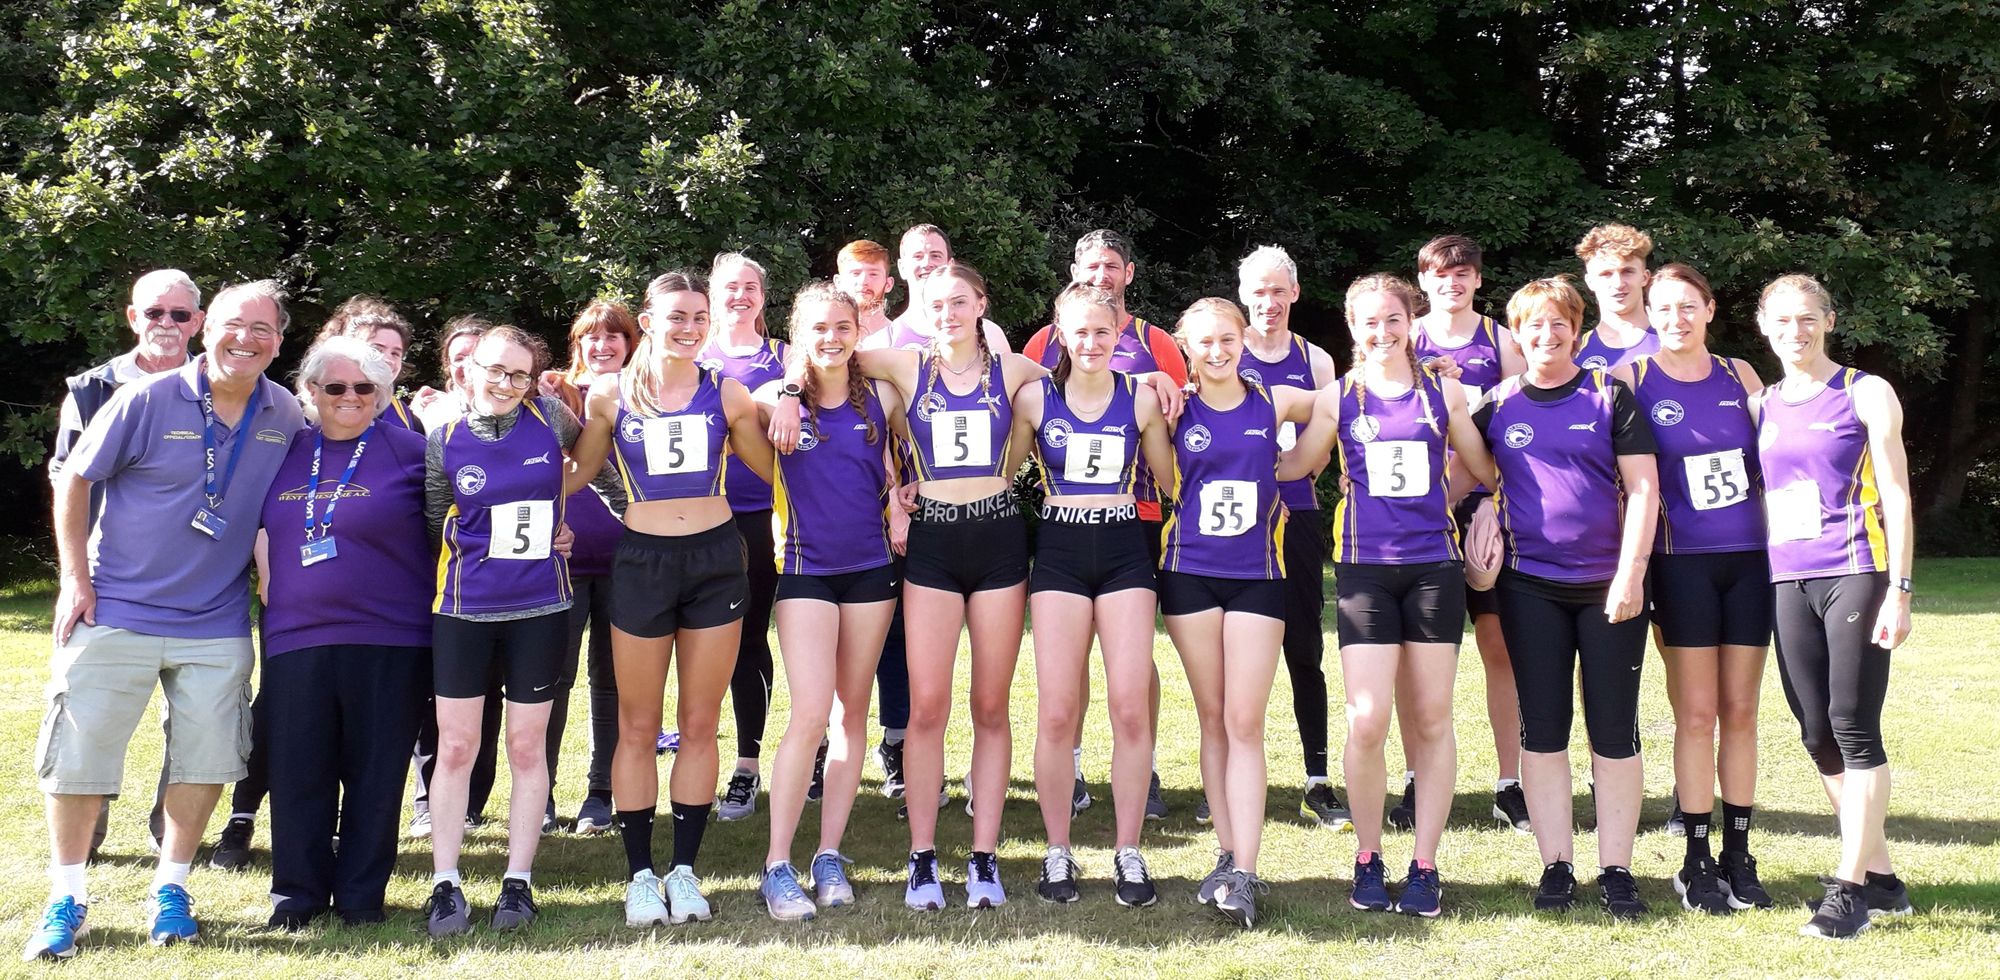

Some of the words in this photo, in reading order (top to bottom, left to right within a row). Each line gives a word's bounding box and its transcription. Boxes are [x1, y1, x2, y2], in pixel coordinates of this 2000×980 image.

[206, 448, 215, 470] UKA
[352, 441, 367, 458] UKA
[668, 437, 685, 468] 5
[954, 431, 969, 461] 5
[311, 459, 320, 475] UKA
[1084, 454, 1101, 478] 5
[1391, 462, 1406, 492] 5
[330, 484, 345, 502] UKA
[1704, 471, 1739, 504] 55
[306, 500, 314, 519] UKA
[923, 506, 958, 522] PRO
[966, 492, 1006, 519] NIKE
[1055, 506, 1101, 524] NIKE
[1105, 504, 1136, 523] PRO
[1211, 502, 1243, 531] 55
[512, 523, 531, 554] 5
